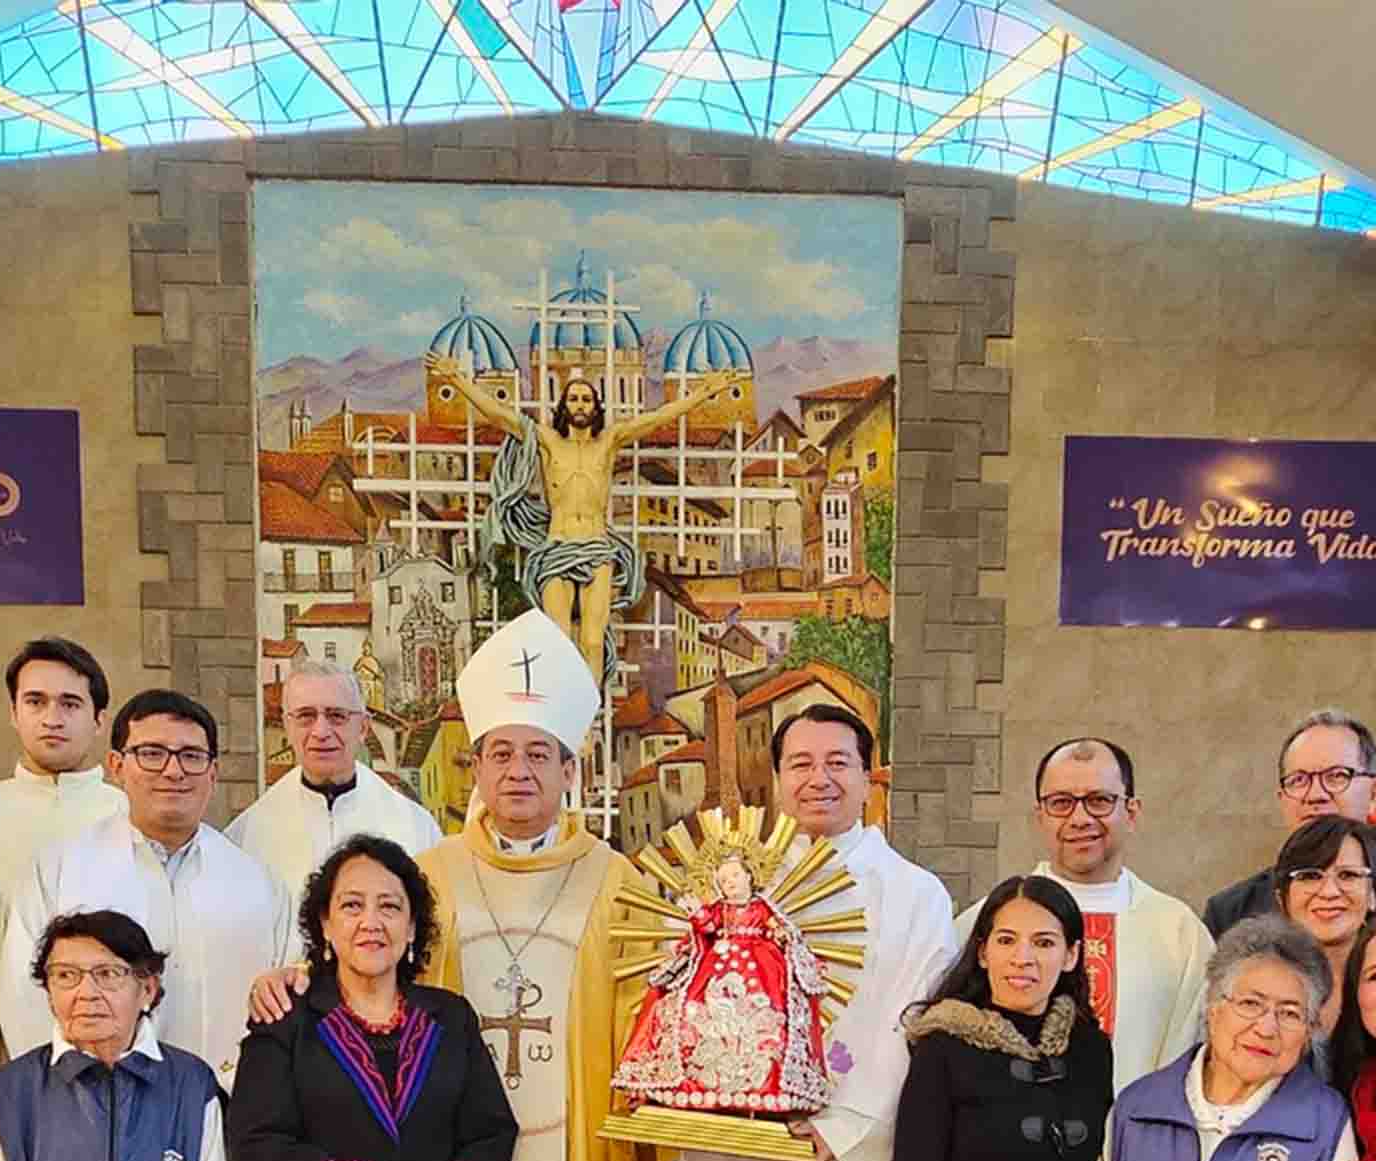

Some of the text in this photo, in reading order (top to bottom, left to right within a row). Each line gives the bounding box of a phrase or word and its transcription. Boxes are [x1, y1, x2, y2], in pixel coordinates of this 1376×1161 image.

[1195, 500, 1292, 531] Sueño
[1301, 505, 1355, 537] que
[1100, 529, 1297, 568] Transforma
